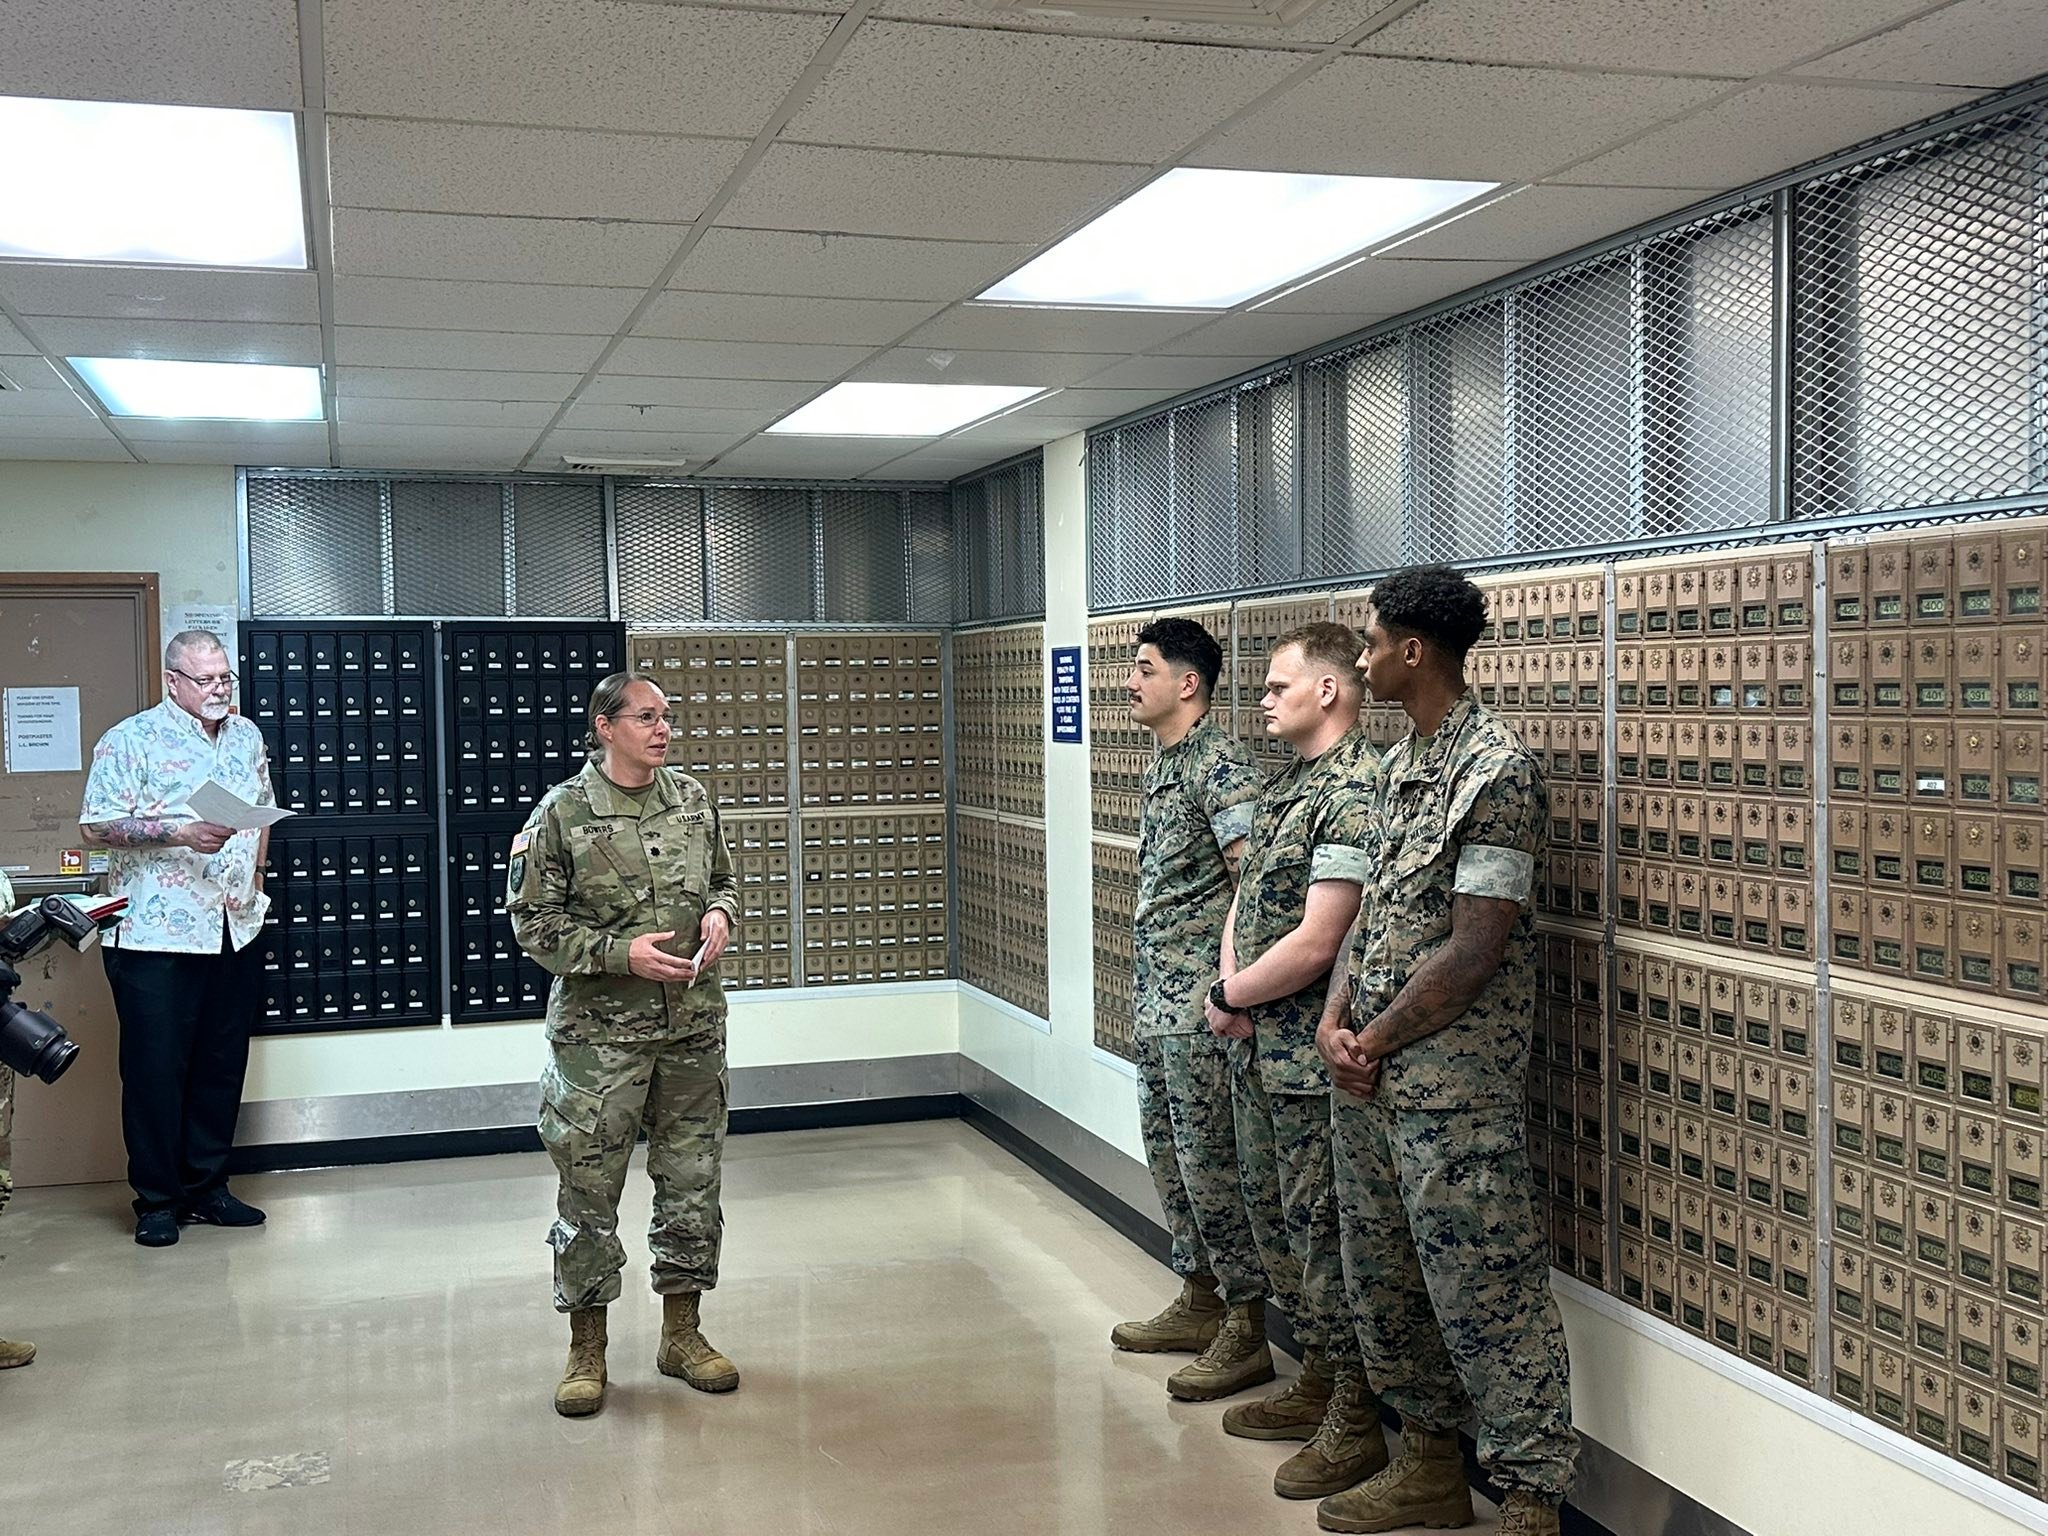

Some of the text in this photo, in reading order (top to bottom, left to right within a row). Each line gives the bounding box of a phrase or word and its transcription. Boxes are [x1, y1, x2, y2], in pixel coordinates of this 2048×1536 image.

[1924, 600, 1943, 611] 400
[1970, 599, 1987, 608] 390
[2017, 595, 2036, 605] 380
[1843, 690, 1857, 699] 421
[1883, 690, 1897, 699] 411
[1926, 691, 1942, 700] 401
[1970, 690, 1985, 700] 391
[2018, 689, 2034, 701] 381
[1883, 777, 1897, 786] 412
[1970, 781, 1987, 792] 392
[2017, 784, 2035, 795] 382
[1883, 863, 1897, 873] 413
[1925, 867, 1942, 878] 403
[1970, 872, 1987, 883] 393
[2018, 878, 2036, 889] 383
[1883, 949, 1897, 960] 414
[1926, 956, 1943, 967] 404
[1970, 965, 1987, 975] 394
[2018, 973, 2035, 984] 384
[1927, 1069, 1944, 1082] 405
[2018, 1092, 2036, 1104] 385
[1885, 1229, 1899, 1241] 417
[1926, 1245, 1943, 1258] 407
[1971, 1262, 1987, 1275] 397
[2020, 1277, 2036, 1291] 387
